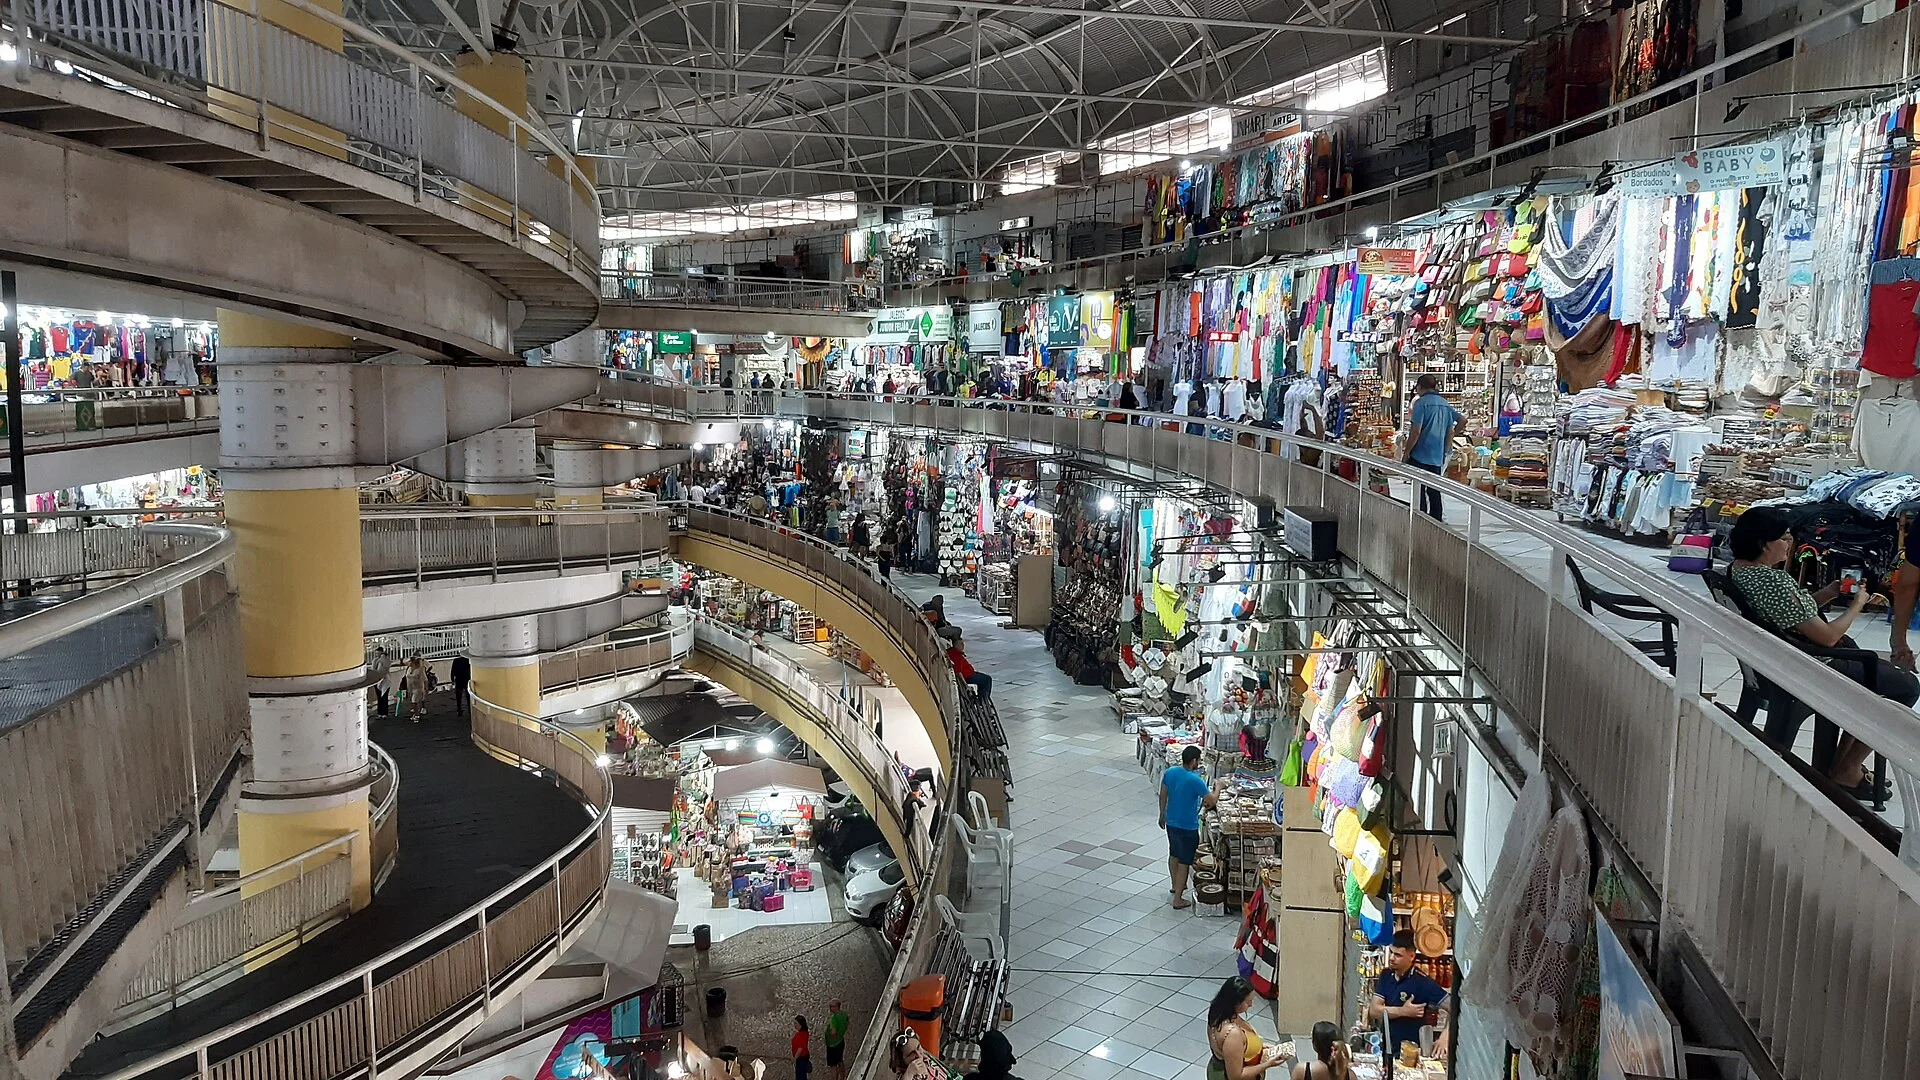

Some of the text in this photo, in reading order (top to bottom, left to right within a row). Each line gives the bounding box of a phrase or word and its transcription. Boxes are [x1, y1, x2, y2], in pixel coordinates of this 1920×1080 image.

[1702, 146, 1754, 159] PEQUENO
[1703, 157, 1754, 174] BABY
[1631, 169, 1671, 178] Barbudinho
[1630, 179, 1664, 187] Bordados
[974, 322, 991, 333] JALECOS
